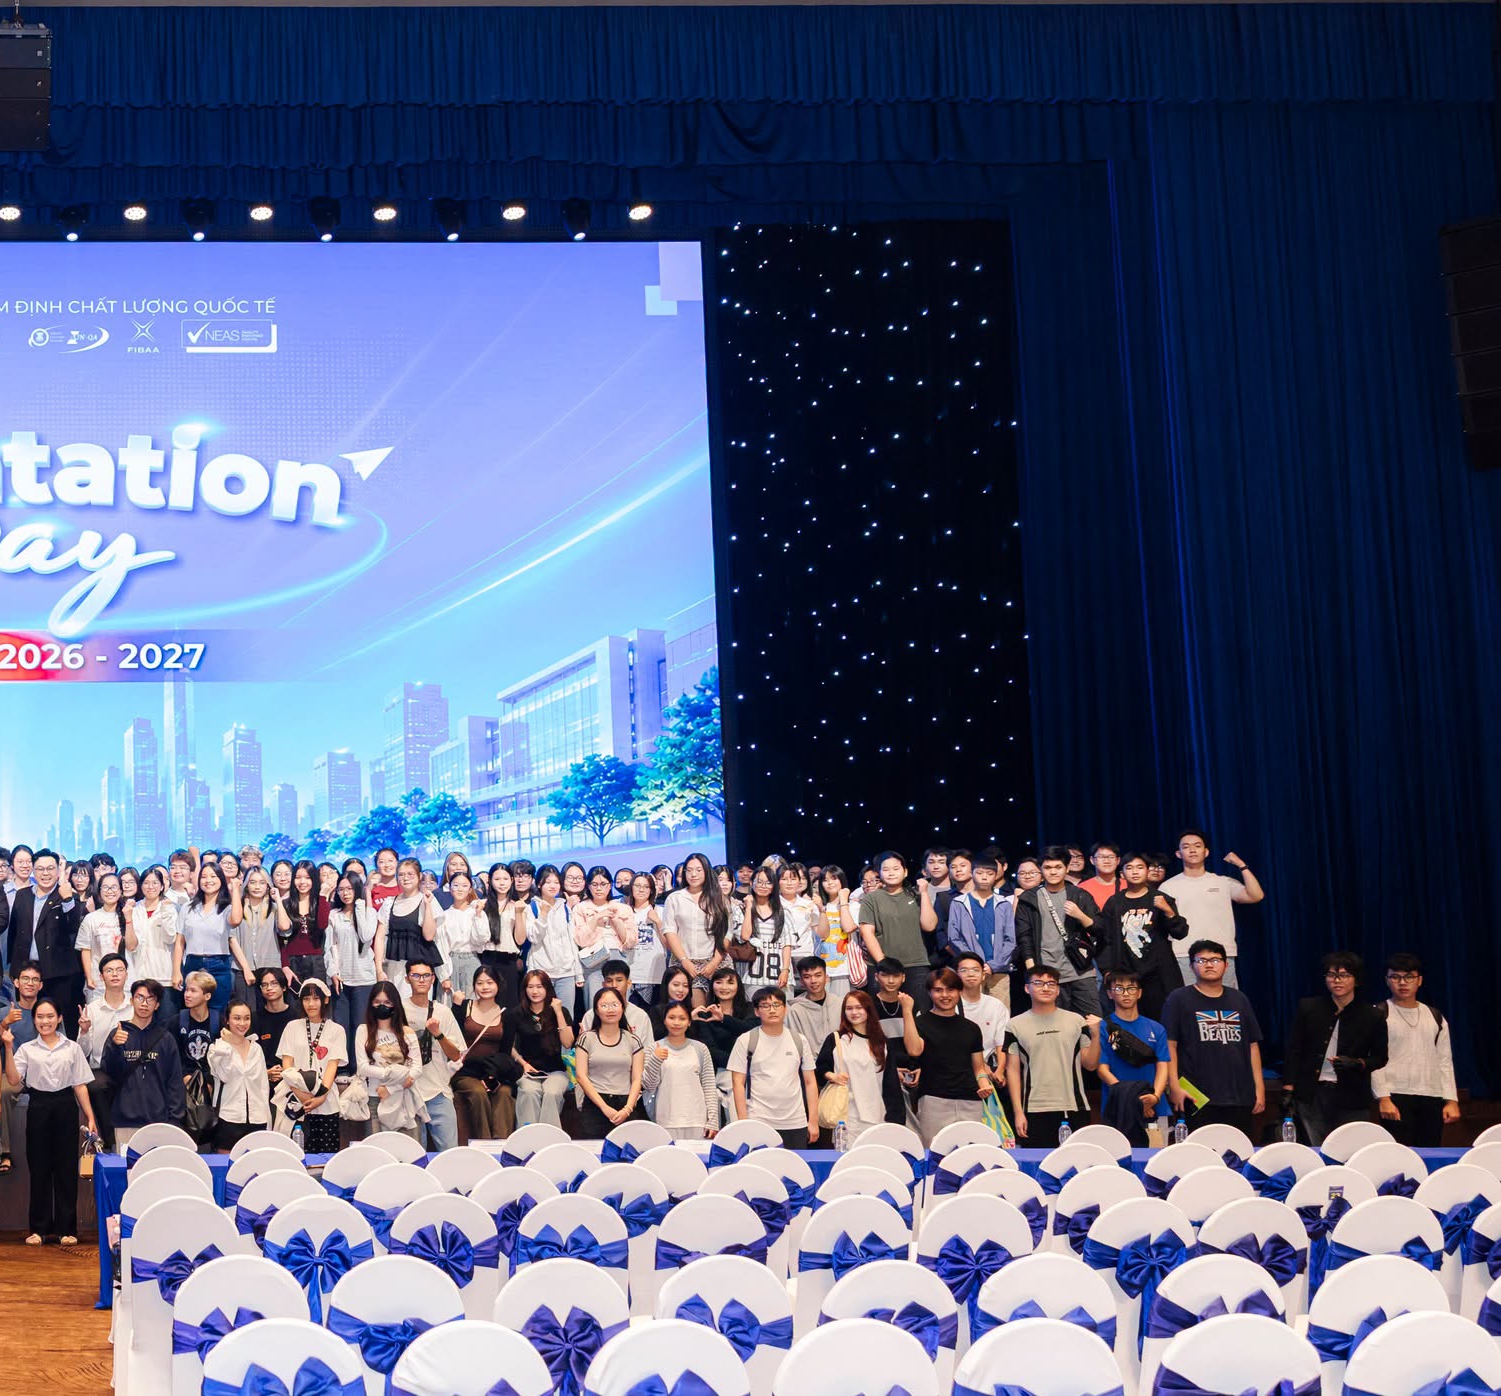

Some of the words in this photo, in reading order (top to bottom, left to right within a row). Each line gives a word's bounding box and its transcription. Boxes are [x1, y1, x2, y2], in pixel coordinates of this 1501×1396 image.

[14, 300, 62, 316] ĐỊNH
[68, 296, 118, 314] CHẤT
[122, 298, 188, 316] LƯỢNG
[193, 296, 249, 316] QUỐC
[253, 296, 276, 314] TẾ
[205, 330, 240, 341] NEAS
[118, 643, 206, 670] 2027
[748, 952, 781, 980] 08
[1198, 1022, 1241, 1044] BEATLES
